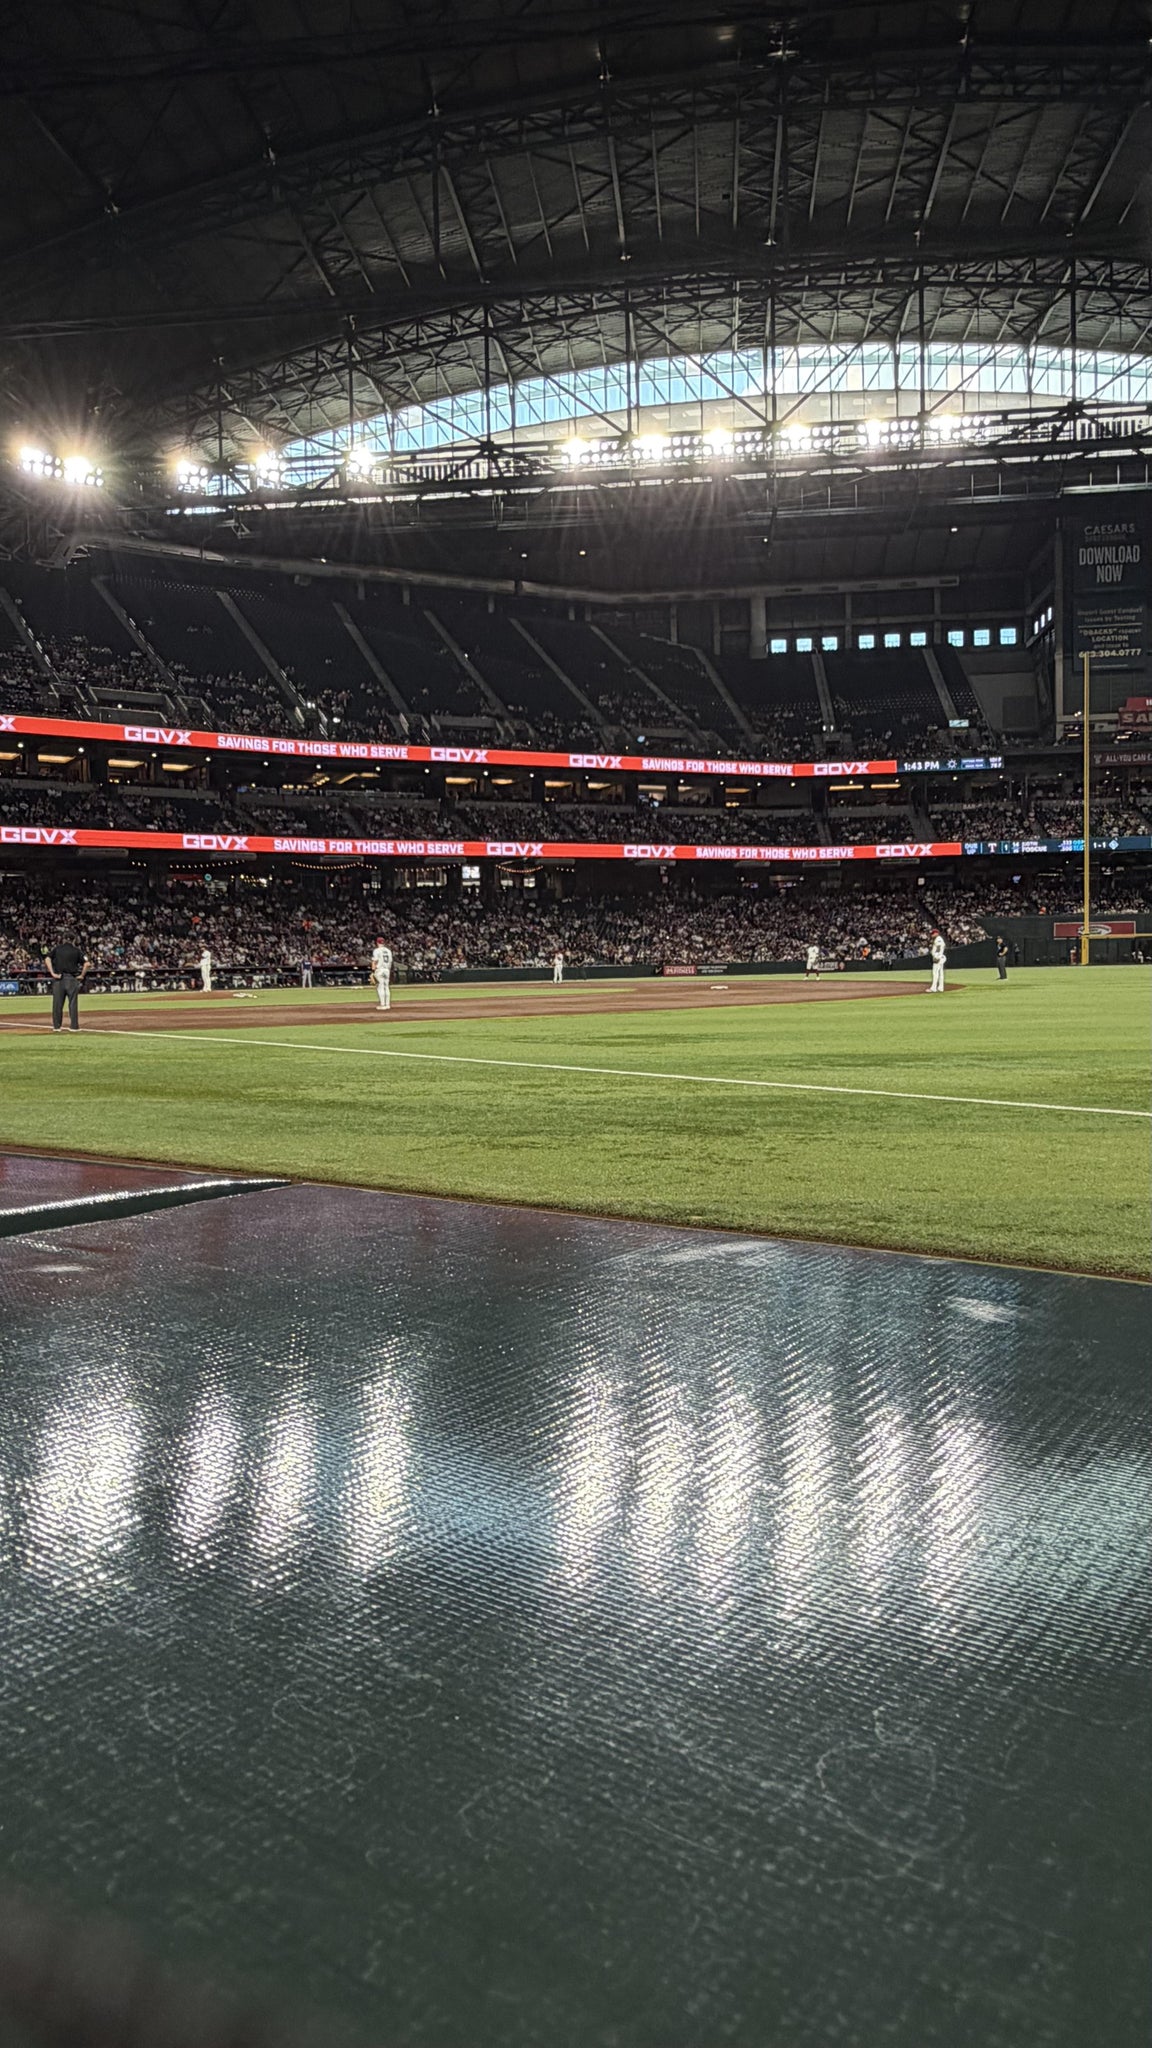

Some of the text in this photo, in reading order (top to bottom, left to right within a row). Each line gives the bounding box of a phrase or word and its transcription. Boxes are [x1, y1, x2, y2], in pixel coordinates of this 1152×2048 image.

[1084, 524, 1136, 535] CAESARS
[1079, 545, 1140, 566] DOWNLOAD
[1096, 564, 1123, 583] NOW
[124, 726, 192, 745] GOVX
[217, 735, 408, 759] SAVINGS FOR THOSE WHO SERVE
[430, 747, 488, 763] GOVX
[569, 753, 623, 768] GOVX
[642, 759, 793, 775] SAVINGS FOR THOSE WHO SERVE
[813, 762, 870, 776] GOVX
[903, 760, 940, 771] 1:43 PM
[1, 827, 78, 844] GOVX
[182, 834, 249, 850] GOVX
[273, 838, 465, 855] SAVINGS FOR THOSE WHO SERVE
[486, 842, 544, 856] GOVX
[623, 844, 677, 858] GOVX
[696, 847, 855, 859] SAVINGS FOR THOSE WHO SERVE
[875, 844, 934, 857] GOVX
[987, 842, 998, 853] T
